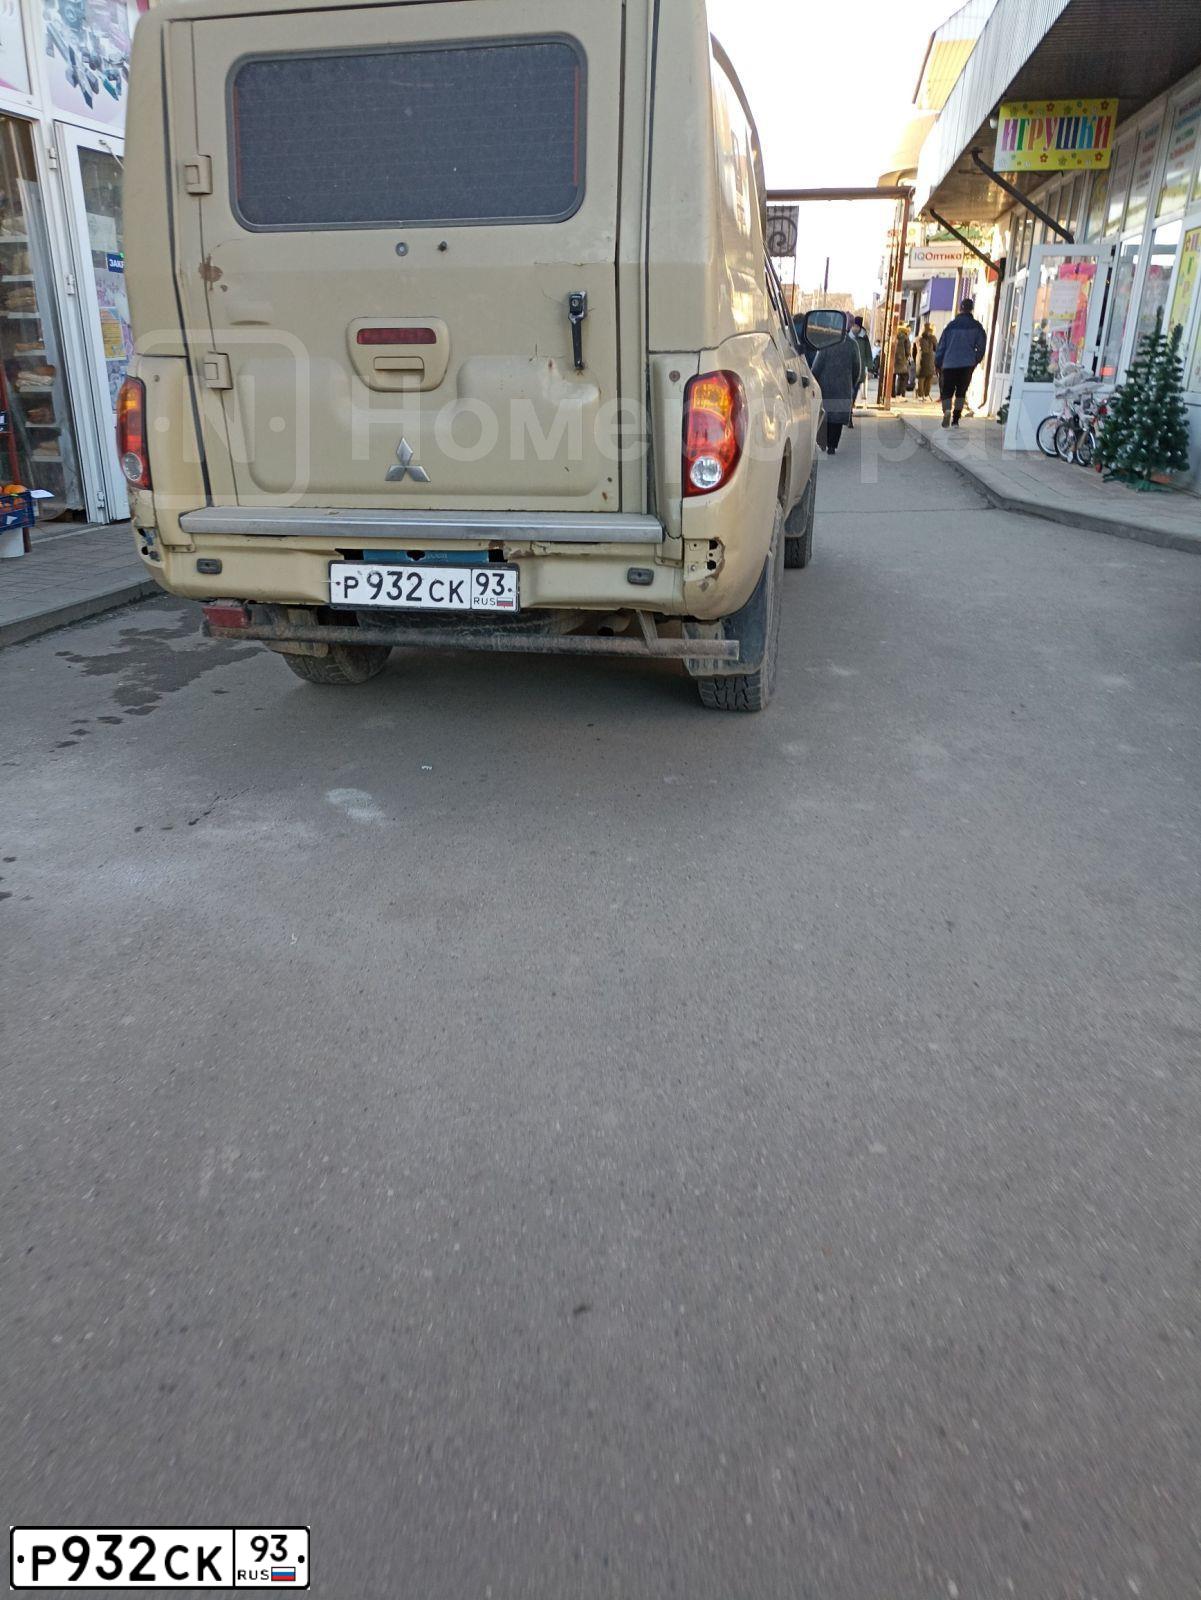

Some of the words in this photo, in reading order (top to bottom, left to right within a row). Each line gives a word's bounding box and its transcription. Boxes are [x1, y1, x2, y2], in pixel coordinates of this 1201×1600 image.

[1001, 115, 1112, 152] ИГРУШКИ
[475, 572, 505, 596] 93
[473, 596, 496, 606] RUS
